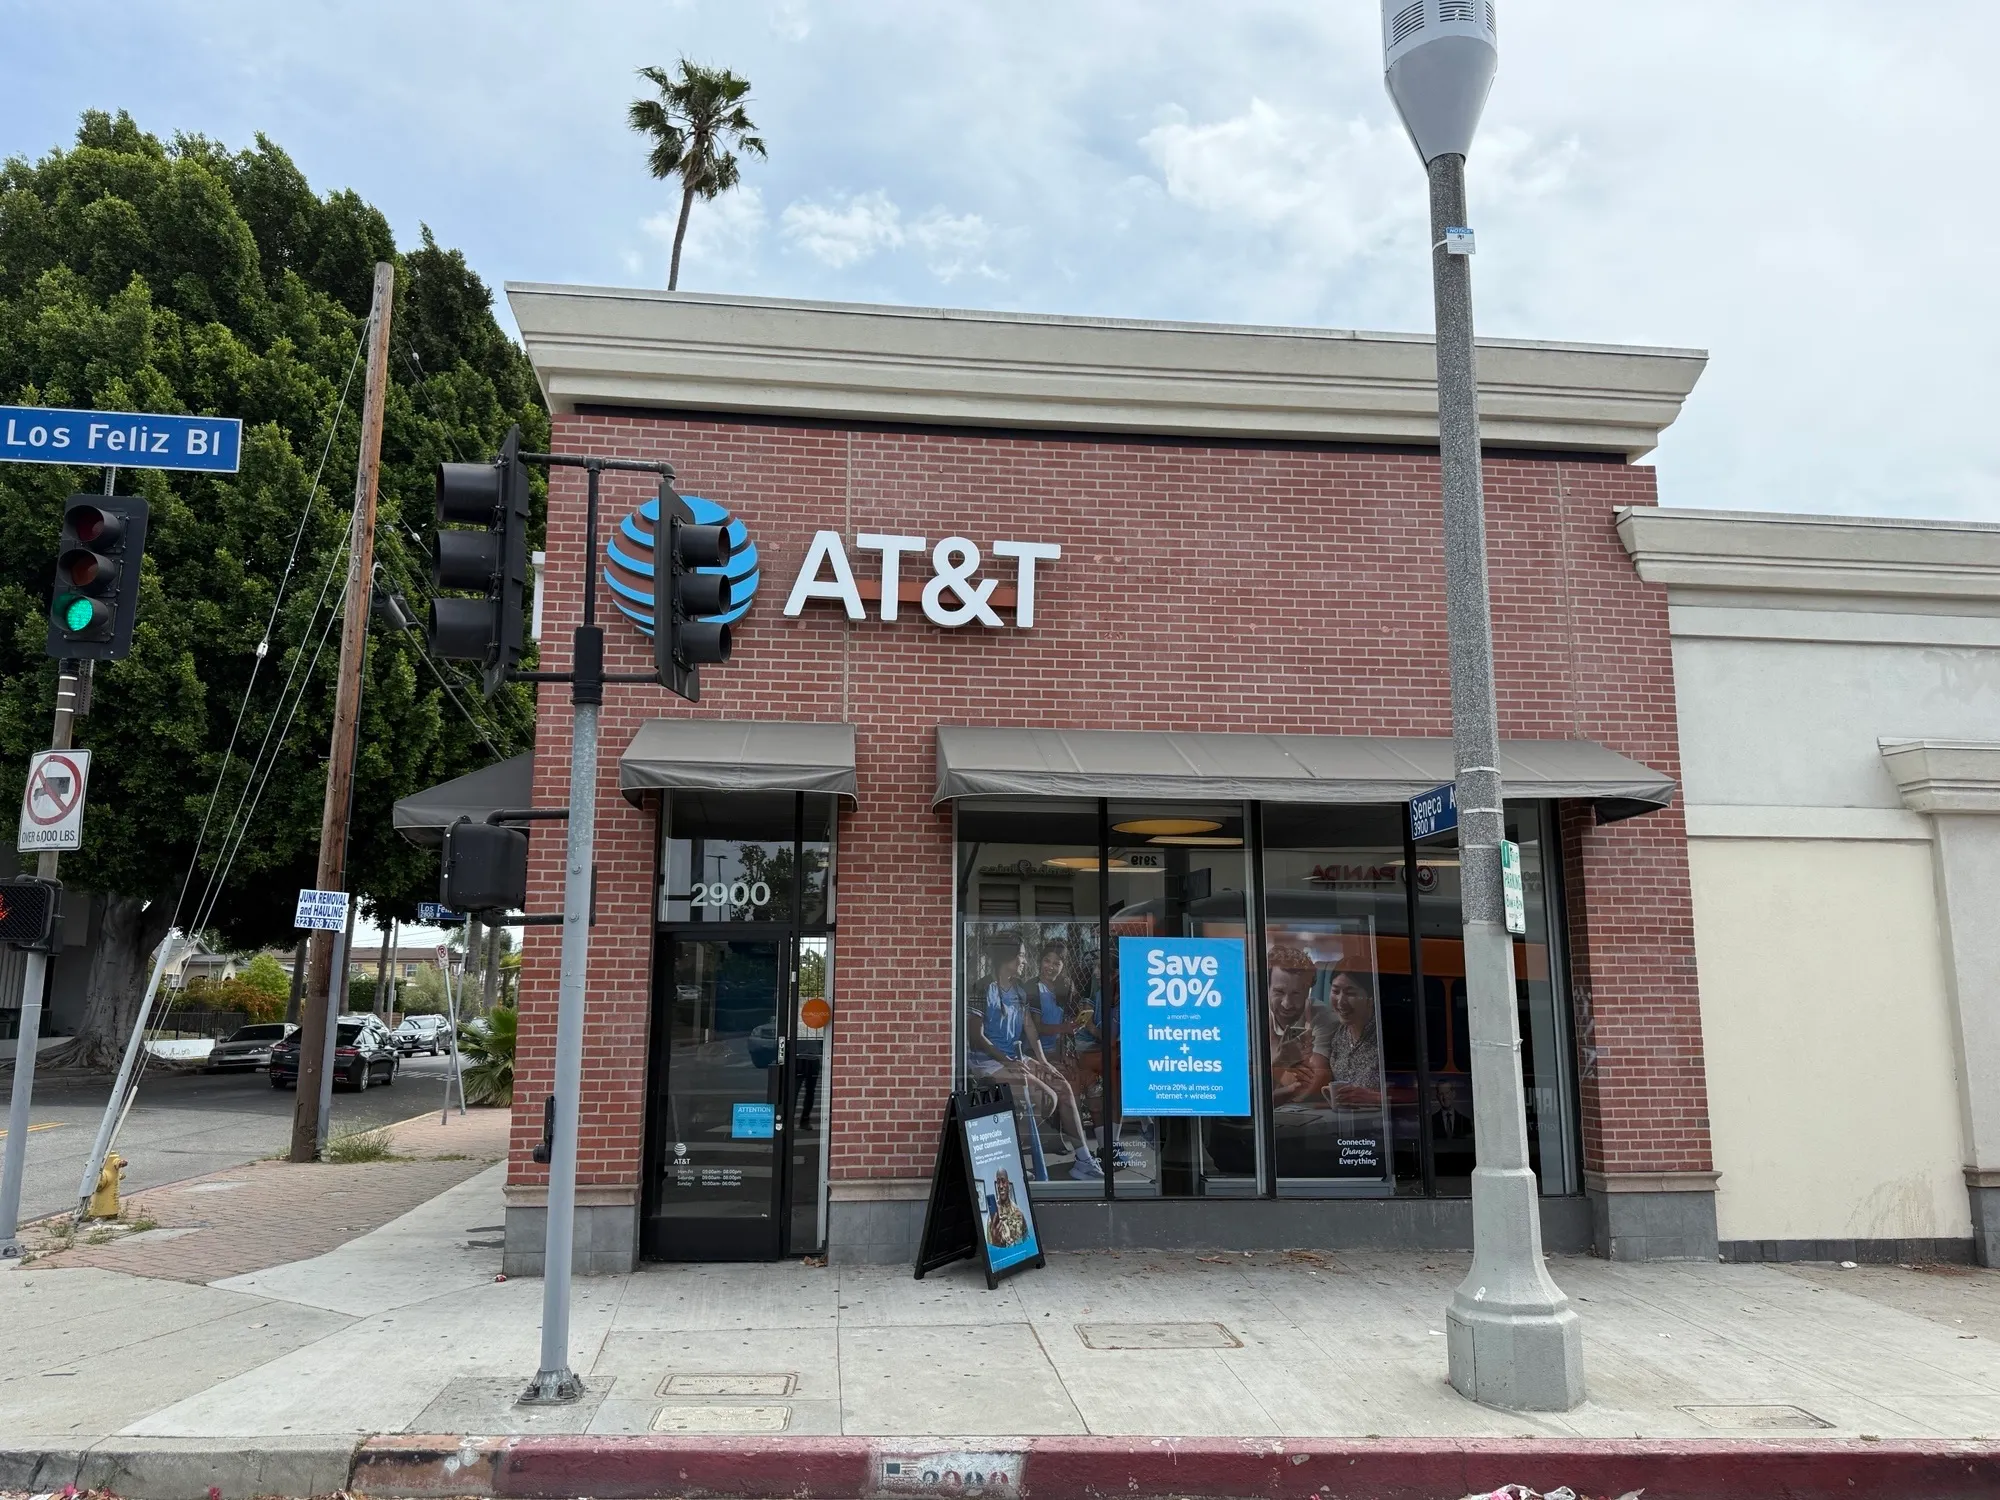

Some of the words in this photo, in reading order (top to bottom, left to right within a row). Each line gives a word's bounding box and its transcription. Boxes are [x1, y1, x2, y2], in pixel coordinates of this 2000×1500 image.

[7, 419, 70, 448] Los
[88, 423, 170, 453] Feliz
[186, 428, 220, 456] Bl
[783, 530, 1062, 629] AT&T
[1412, 796, 1442, 821] Seneca
[1449, 786, 1457, 810] A
[1413, 819, 1429, 836] 3900
[22, 831, 35, 843] OVER
[59, 830, 76, 841] LBS.
[1504, 871, 1521, 891] PARKING
[300, 891, 317, 904] JUNK
[318, 892, 346, 906] REMOVAL
[691, 882, 771, 907] 2900
[300, 904, 312, 915] and
[313, 904, 343, 918] HAULING
[420, 905, 434, 913] Los
[296, 917, 310, 926] 323
[325, 919, 343, 930] 7670
[1147, 949, 1218, 976] Save
[1147, 977, 1222, 1007] 20%
[1148, 1024, 1221, 1041] internet
[1148, 1056, 1222, 1072] wireless
[1188, 1083, 1194, 1091] al
[1190, 1092, 1216, 1100] wireless
[979, 1129, 1002, 1142] appreciate
[1337, 1138, 1376, 1147] Connecting
[972, 1143, 984, 1154] your
[984, 1137, 1012, 1149] commitment
[1112, 1140, 1147, 1148] onnecting
[1341, 1147, 1372, 1157] Changes
